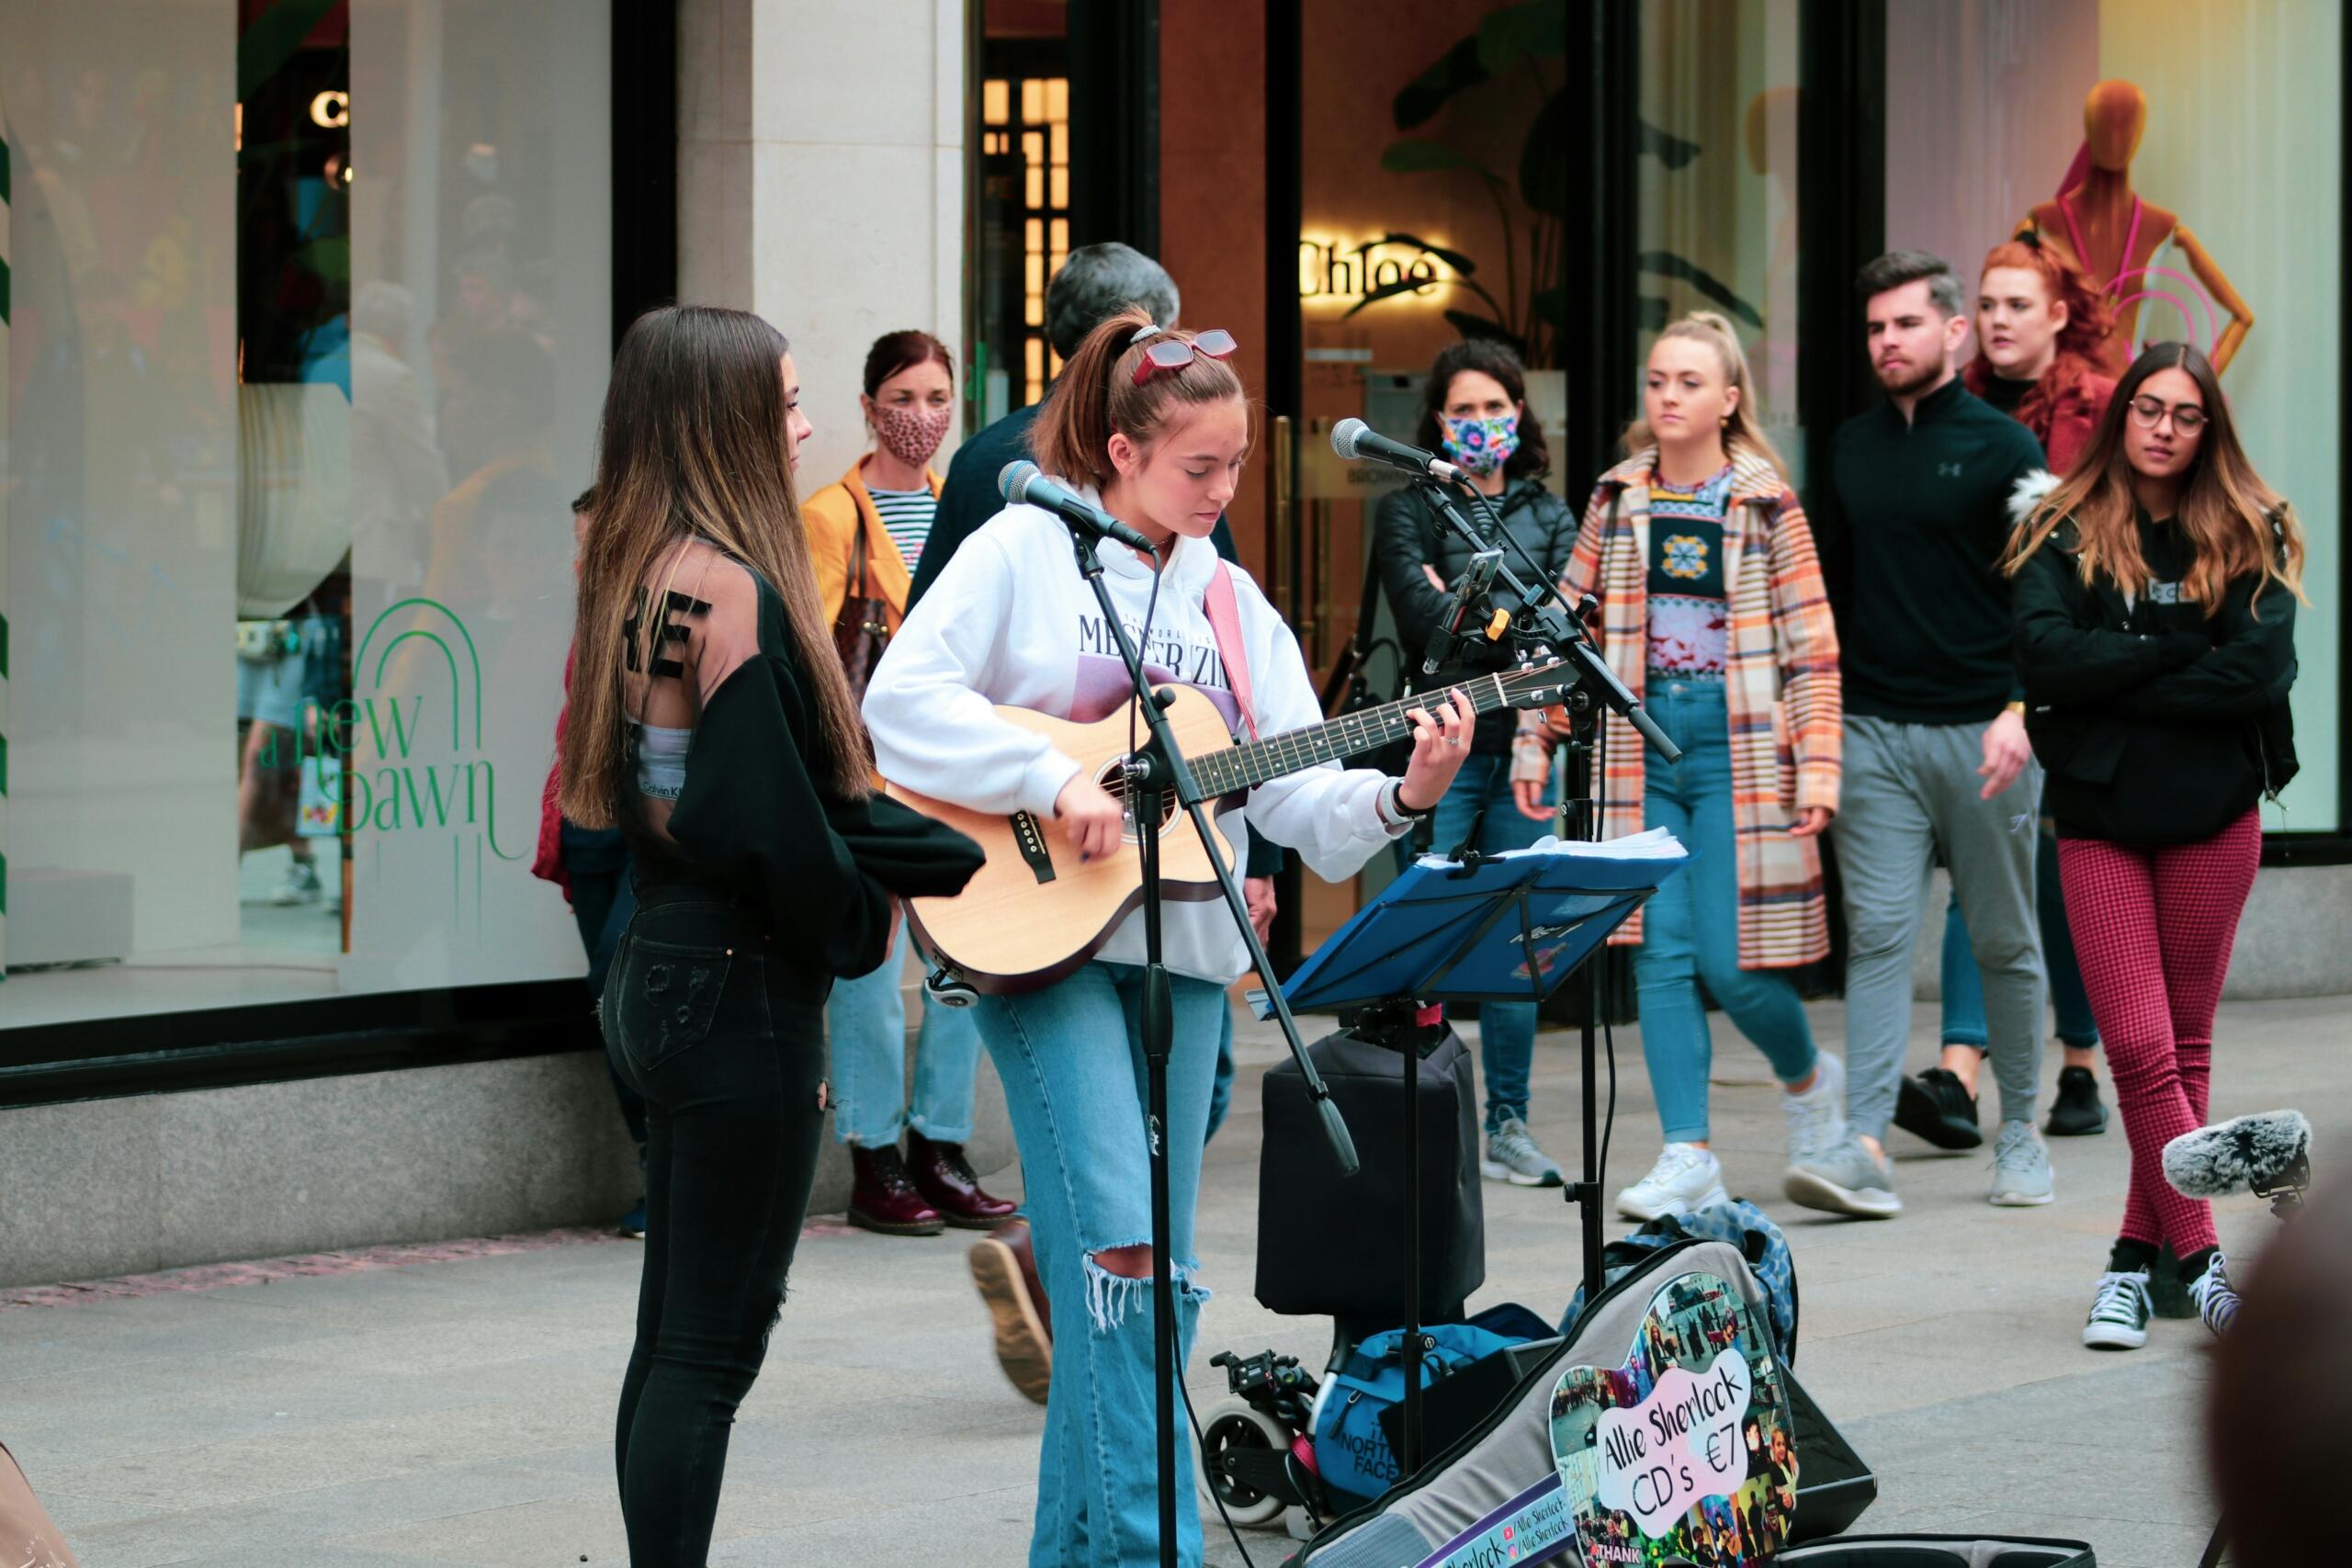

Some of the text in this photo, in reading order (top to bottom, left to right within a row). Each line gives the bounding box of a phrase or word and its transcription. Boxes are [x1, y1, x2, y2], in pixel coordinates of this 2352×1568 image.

[295, 695, 423, 802] new
[1605, 1366, 1743, 1474] Allie Sherlock
[1353, 1455, 1397, 1482] FACE
[1632, 1421, 1736, 1517] CD's €7
[1535, 1516, 1568, 1544] Sherlock
[1597, 1543, 1641, 1564] THANK
